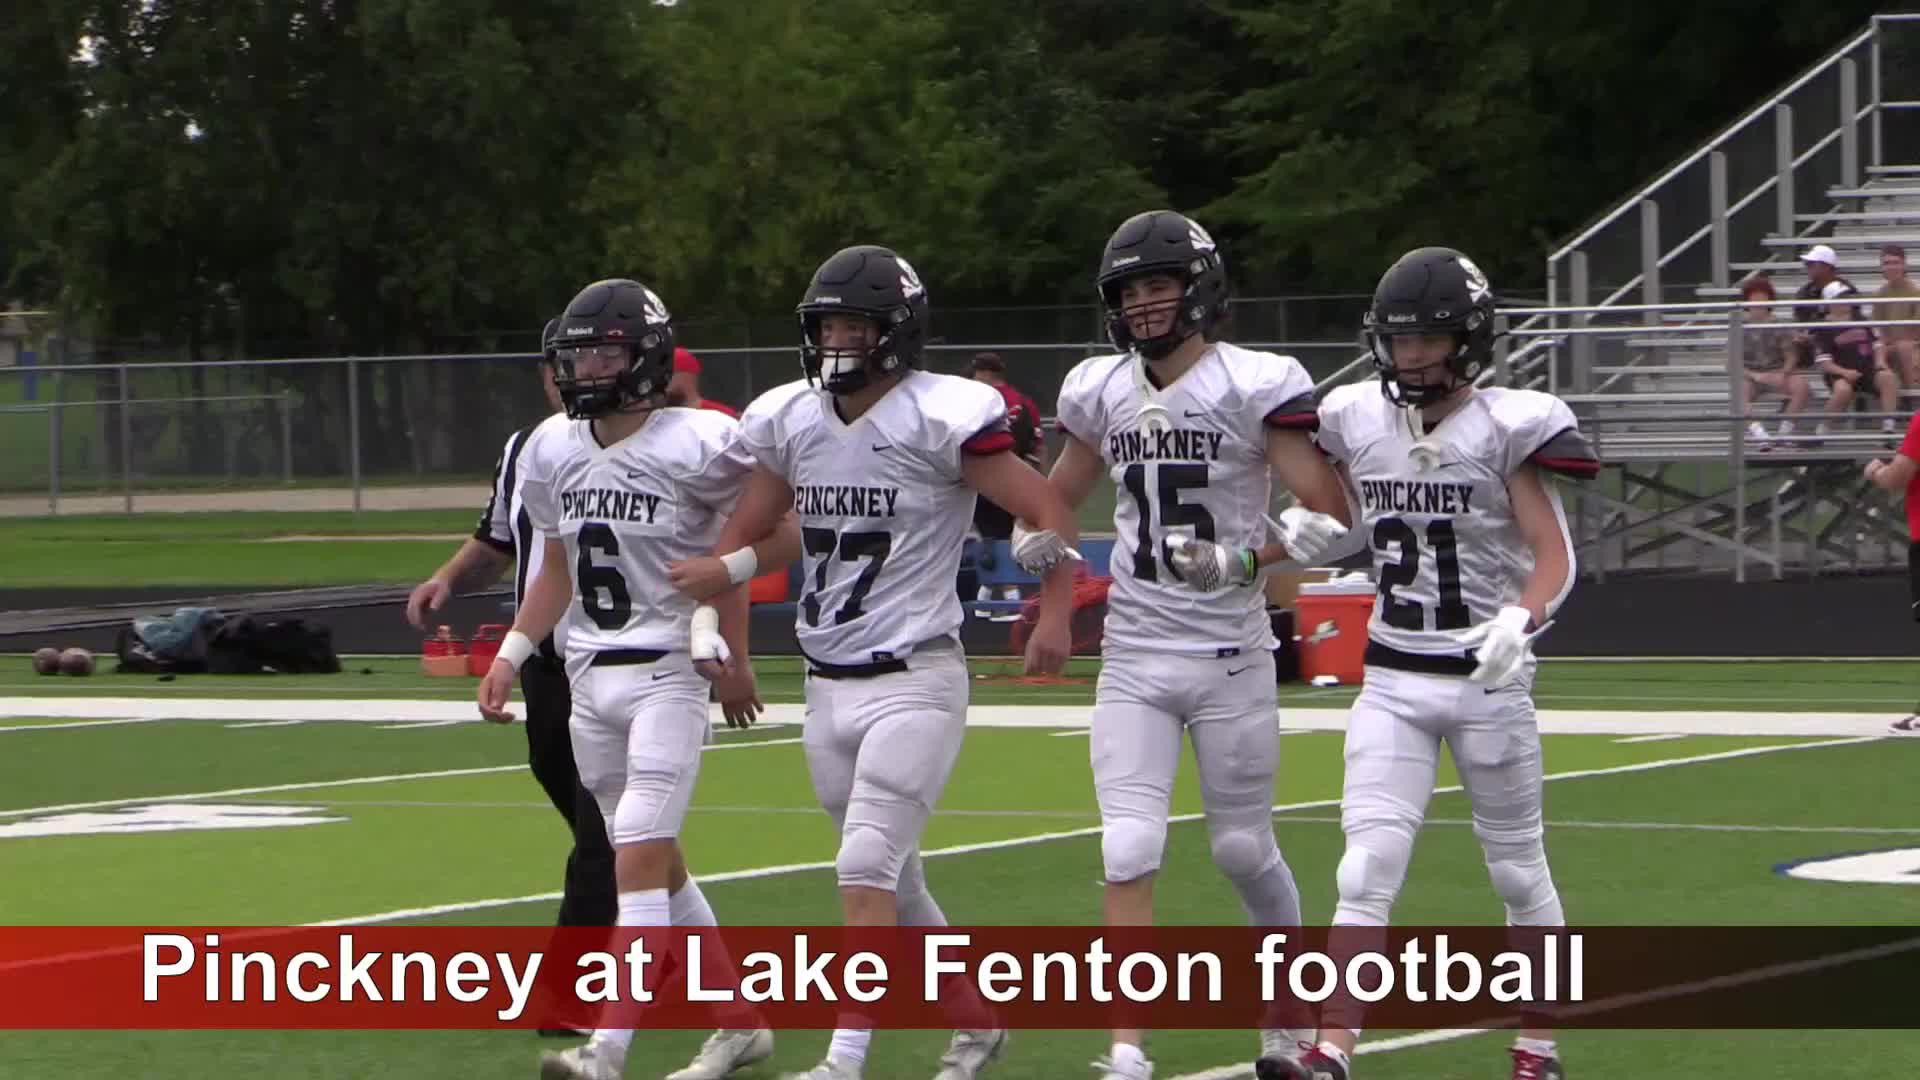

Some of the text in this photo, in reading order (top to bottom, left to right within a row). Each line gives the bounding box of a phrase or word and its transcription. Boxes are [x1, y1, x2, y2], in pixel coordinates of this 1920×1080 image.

[1110, 428, 1223, 462] PINCKNEY
[795, 486, 900, 518] PINCKNEY
[1123, 464, 1216, 583] 15
[1360, 480, 1474, 514] PINCKNEY
[577, 522, 632, 631] 6
[801, 527, 892, 628] 77
[1373, 517, 1471, 631] 21
